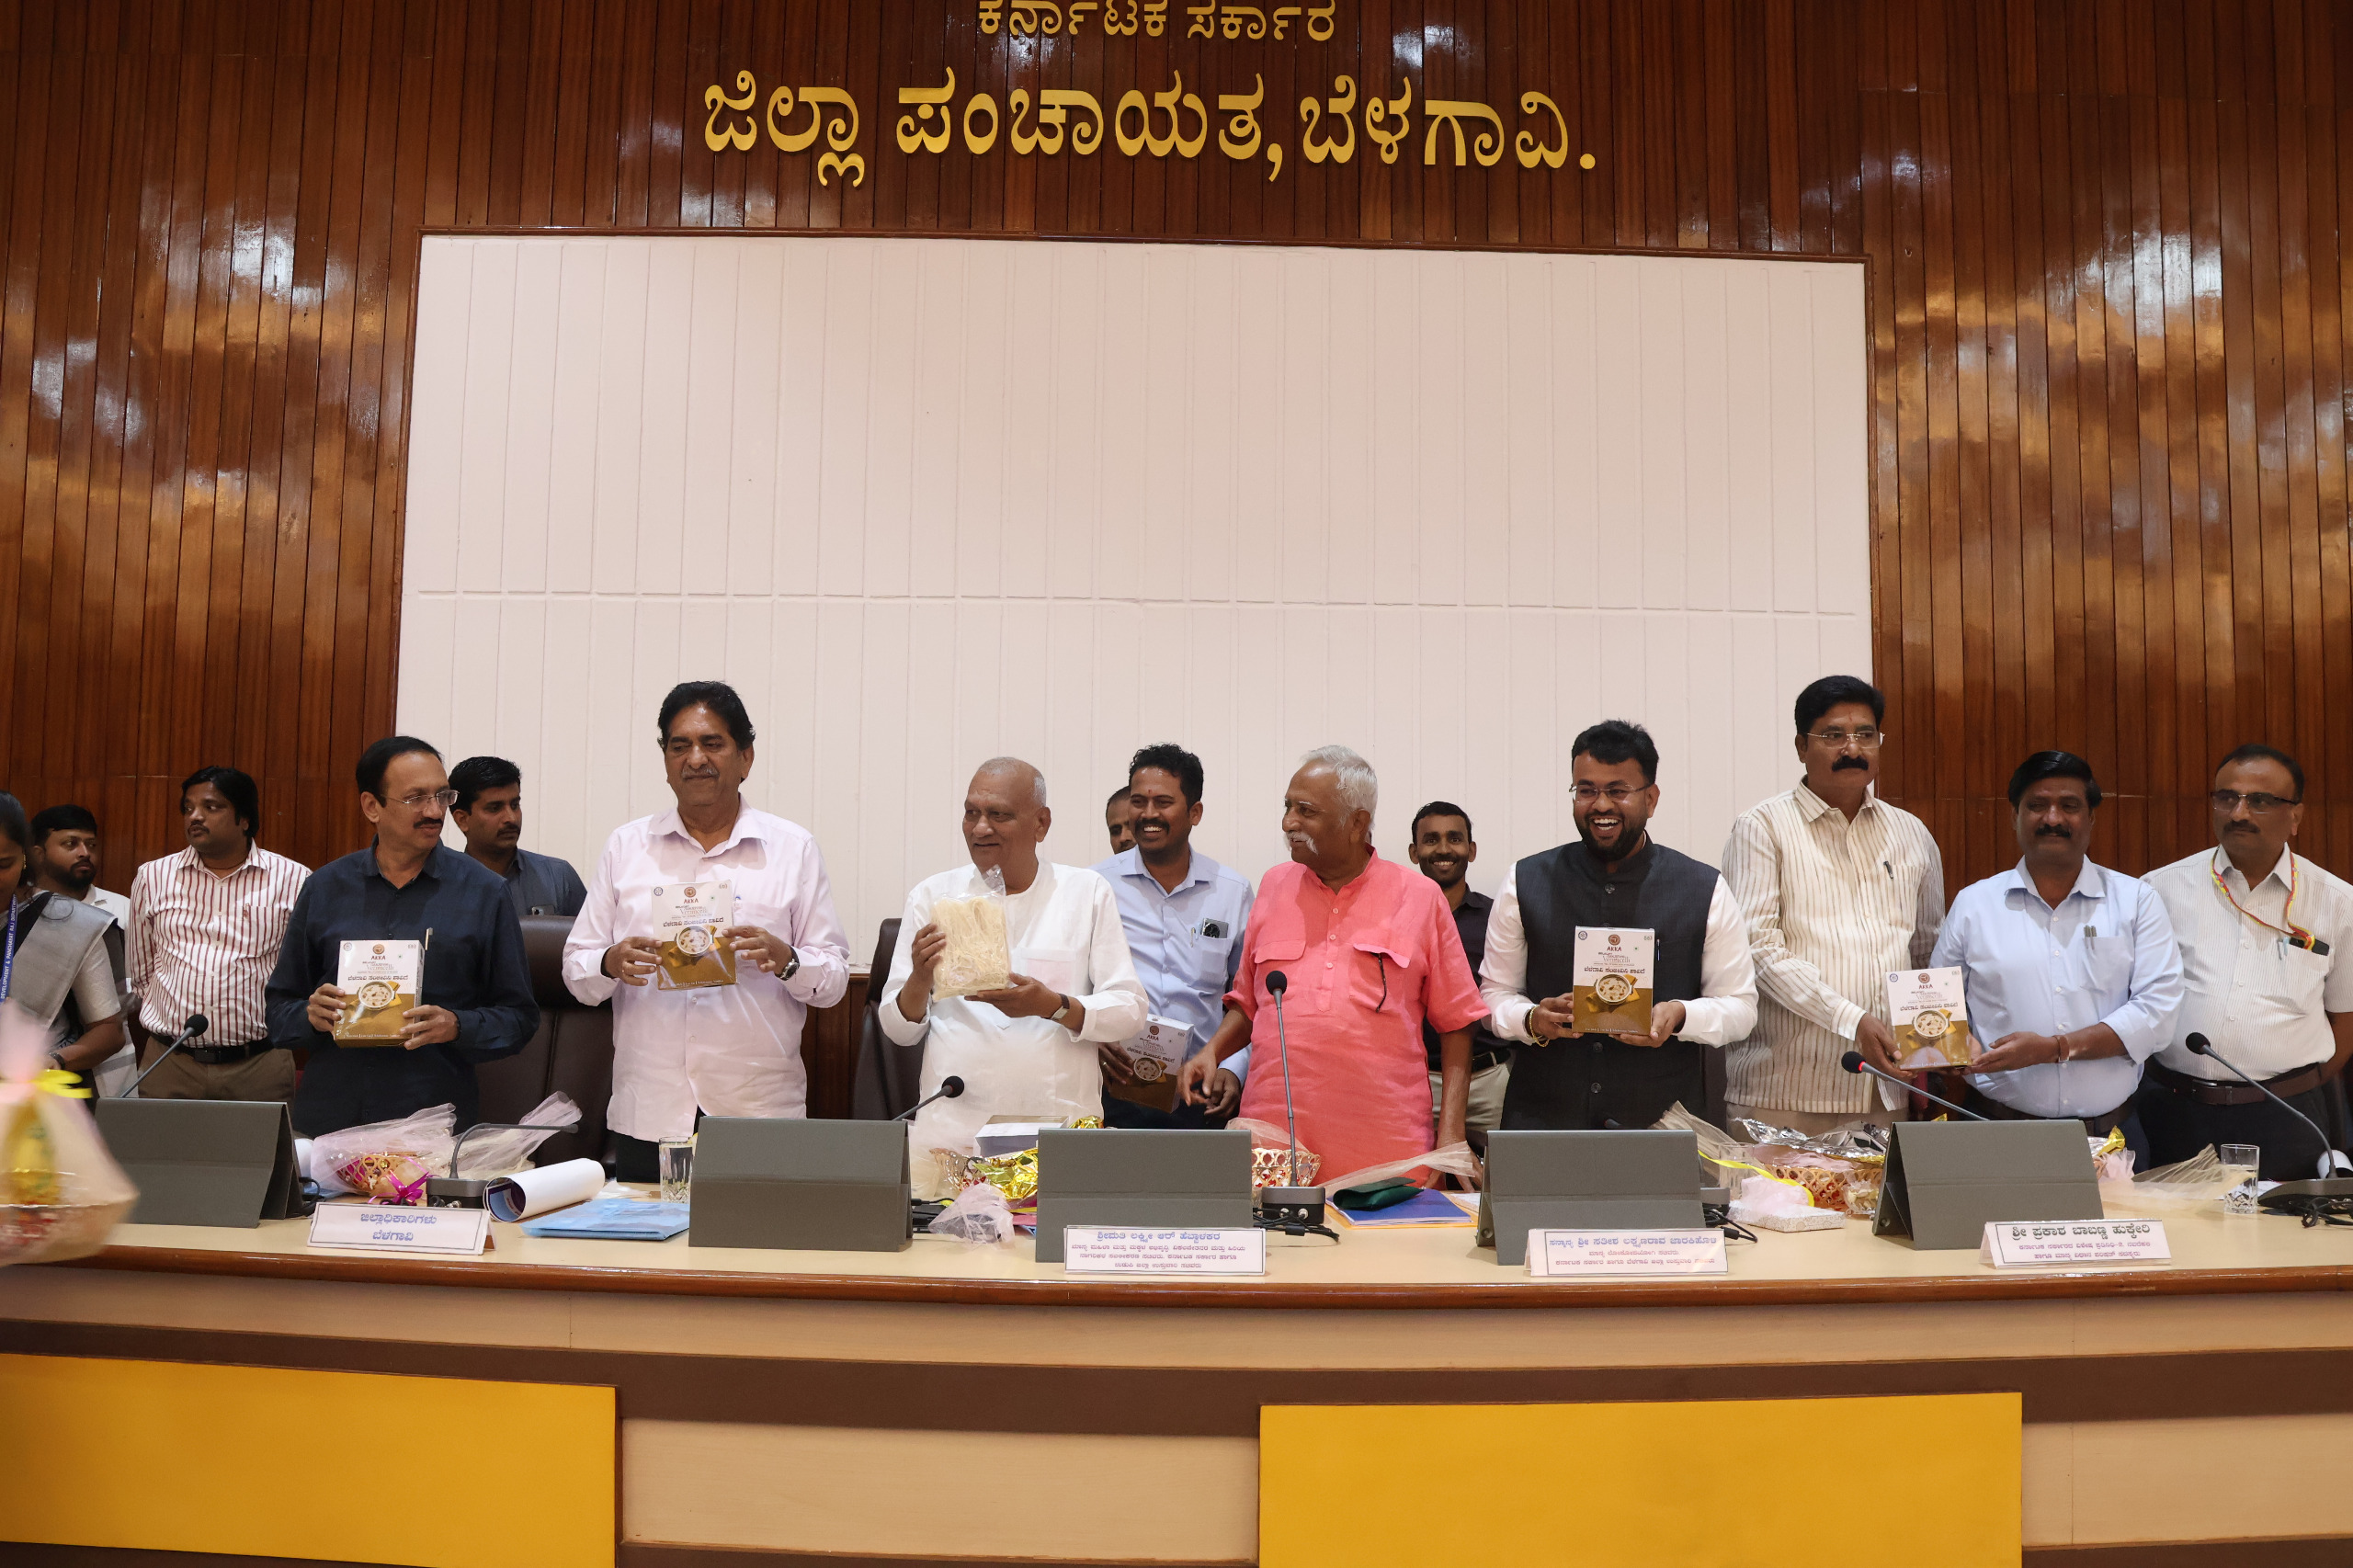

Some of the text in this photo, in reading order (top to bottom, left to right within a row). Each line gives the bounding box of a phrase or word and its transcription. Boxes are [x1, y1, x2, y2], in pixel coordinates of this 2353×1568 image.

[979, 0, 1336, 41] ಕರ್ನಾಟಕ ಸರ್ಕಾರ
[704, 66, 1596, 187] ಜಿಲ್ಲಾ ಪಂಚಾಯತ, ಬೆಳಗಾವಿ.
[373, 1230, 414, 1241] ಬೆಳಗಾವಿ
[1097, 1232, 1125, 1242] ಶ್ರೀಮತಿ
[2012, 1223, 2150, 1241] ಶ್ರೀ ಪ್ರಕಾಶ ಬಾಬಣ್ಣ ಹುಕ್ಕೇರಿ
[1578, 1237, 1588, 1247] ಶ್ರೀ
